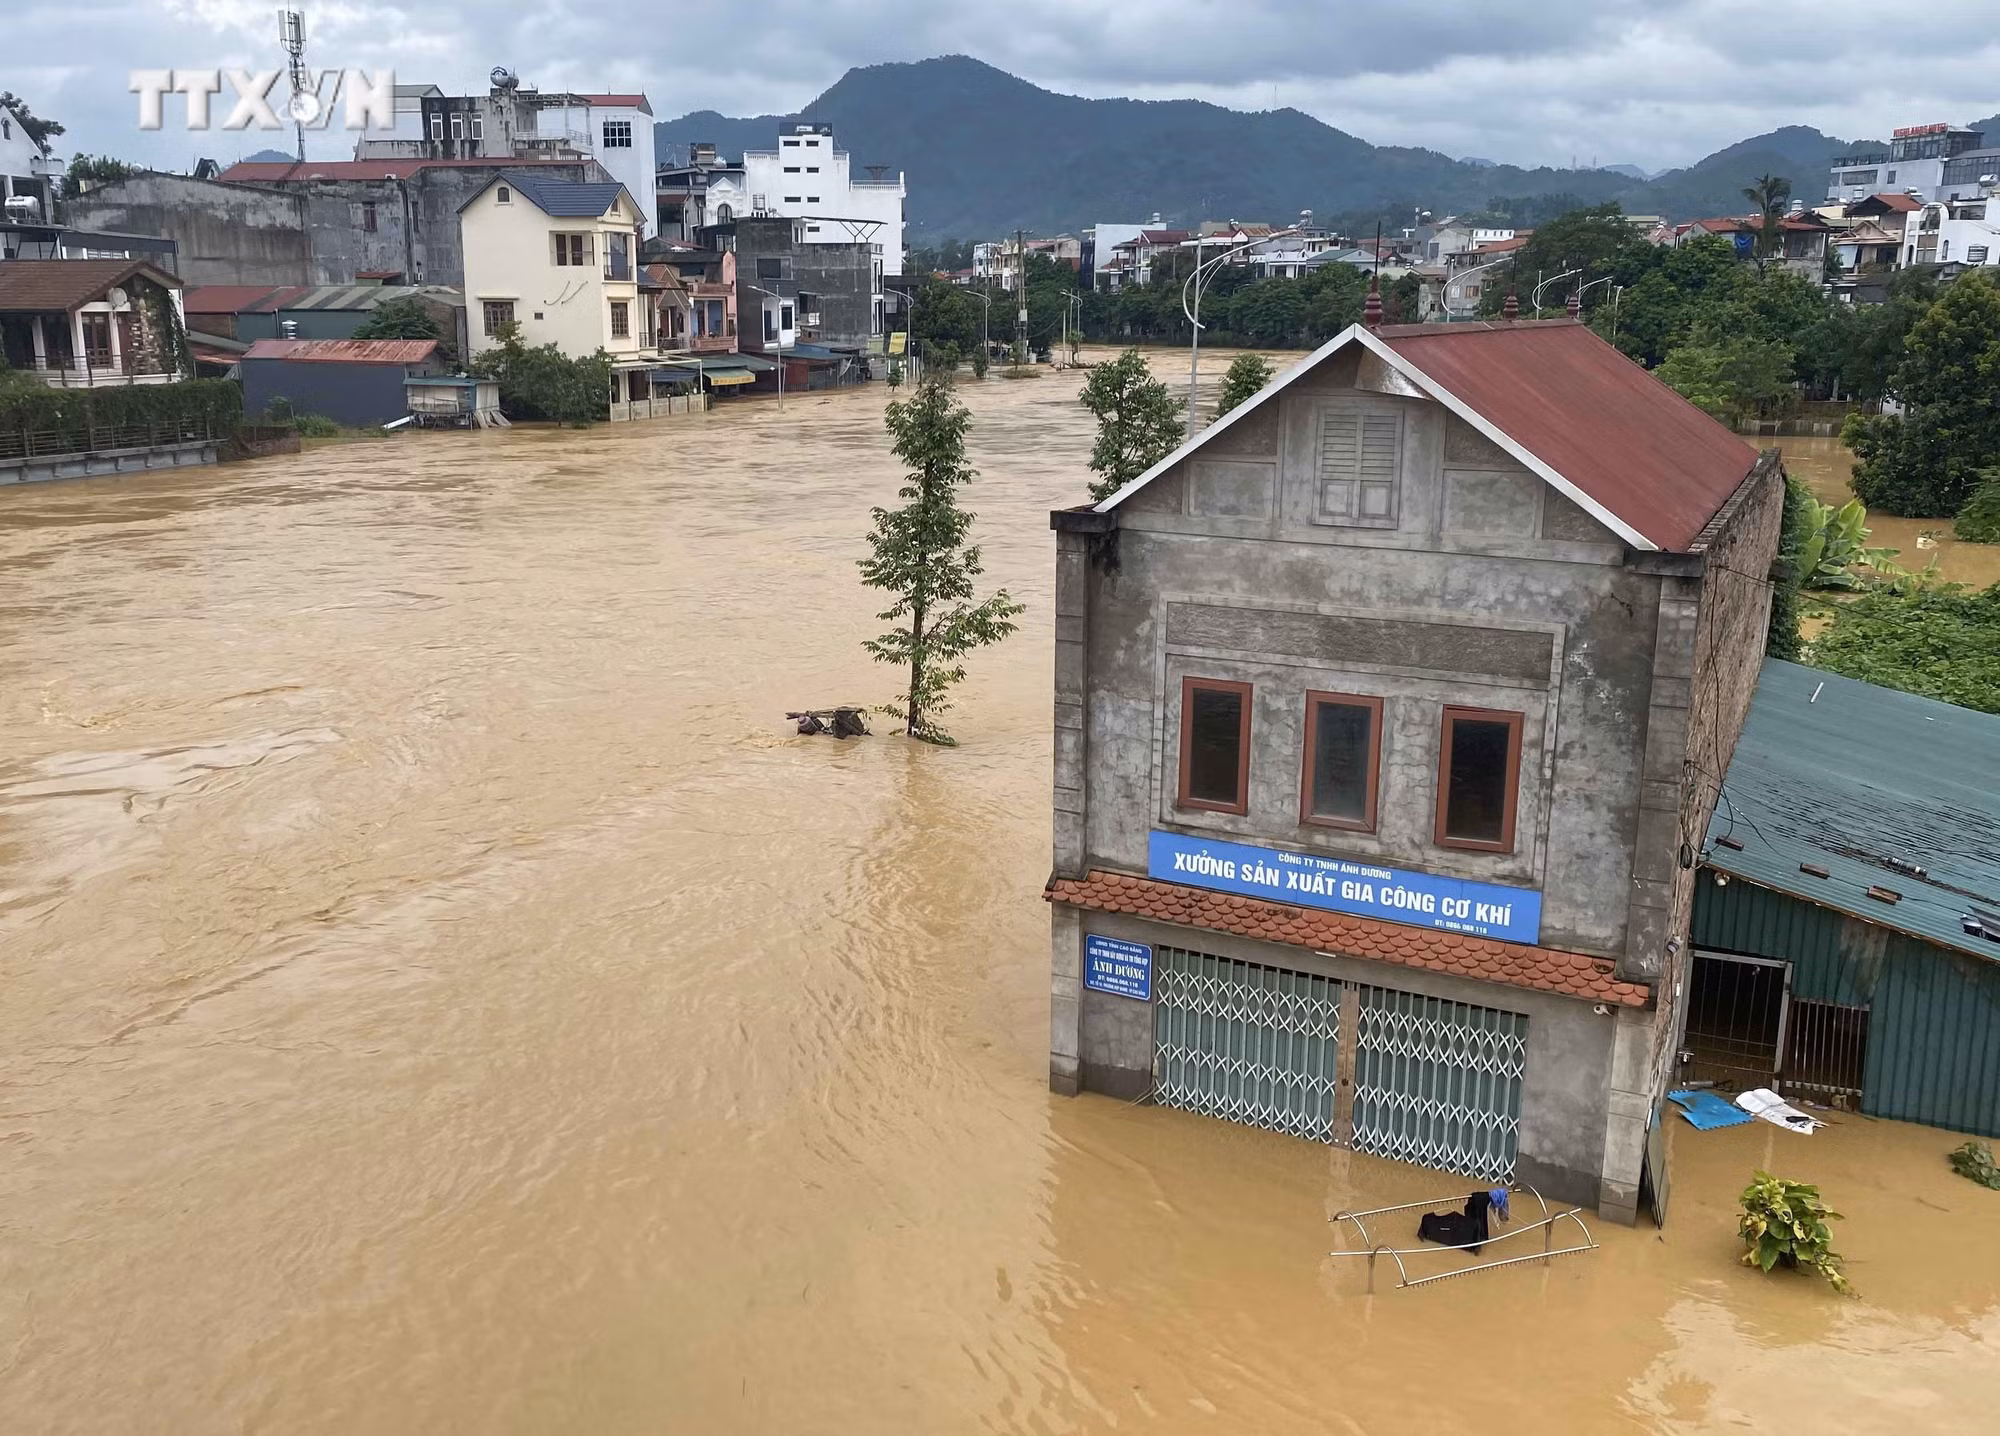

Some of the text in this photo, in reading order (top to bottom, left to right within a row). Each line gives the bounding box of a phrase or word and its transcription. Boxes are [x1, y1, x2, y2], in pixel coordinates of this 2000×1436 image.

[1278, 853, 1302, 865] CÔNG
[1303, 857, 1314, 867] TY
[1316, 859, 1338, 871] TNHH
[1361, 866, 1392, 880] DƯƠNG
[1174, 850, 1512, 927] XƯỞNG SẢN XUẤT GIA CÔNG CƠ KHÍ
[1093, 957, 1145, 981] ÁNH DƯƠNG
